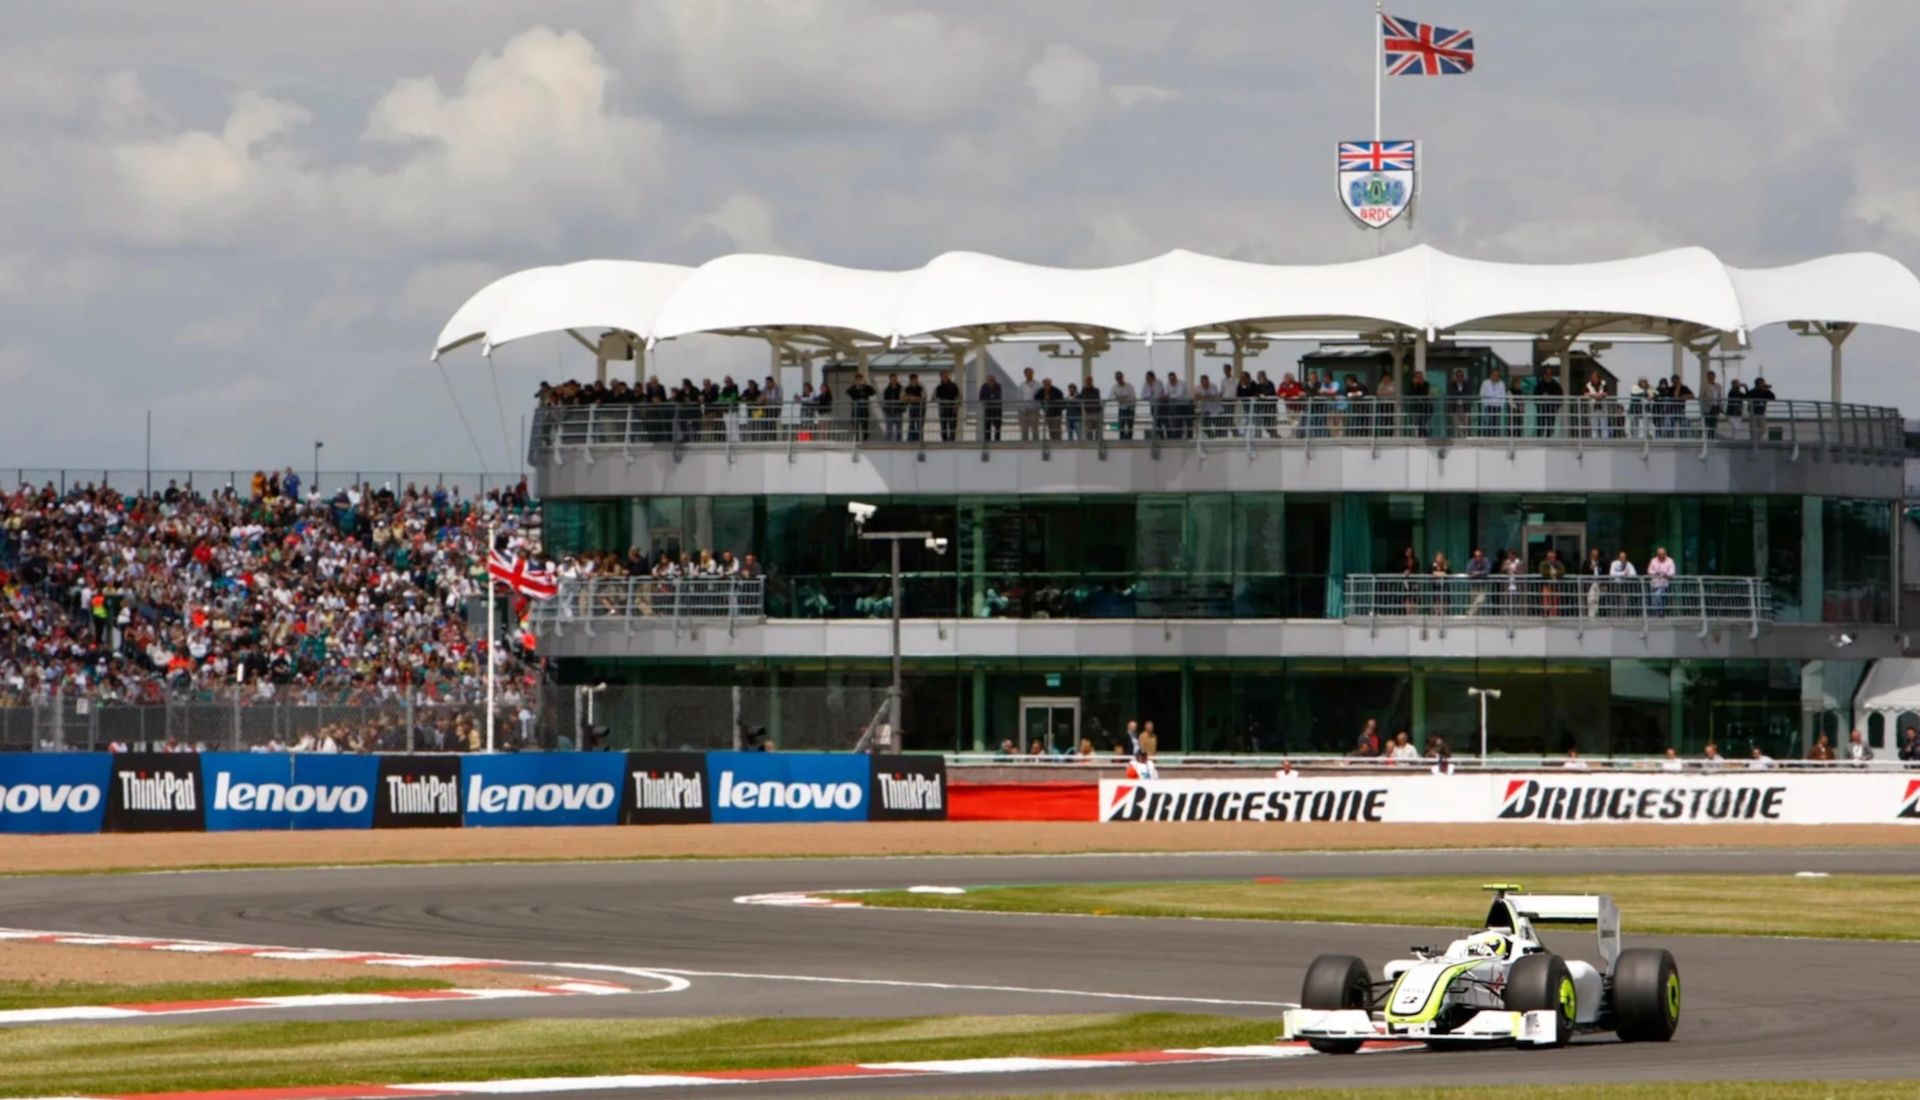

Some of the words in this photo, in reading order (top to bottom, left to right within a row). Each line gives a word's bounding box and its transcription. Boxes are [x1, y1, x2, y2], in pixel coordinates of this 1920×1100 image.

[0, 784, 101, 813] ovo
[118, 770, 196, 811] ThinkPad
[214, 772, 368, 812] lenovo
[386, 775, 458, 814] ThinkPad
[466, 774, 615, 813] lenovo
[632, 771, 703, 809] ThinkPad
[718, 771, 863, 810] lenovo
[877, 772, 942, 810] ThinkPad
[1109, 786, 1388, 821] BRIDGESTONE
[1498, 780, 1786, 820] BRIDGESTONE
